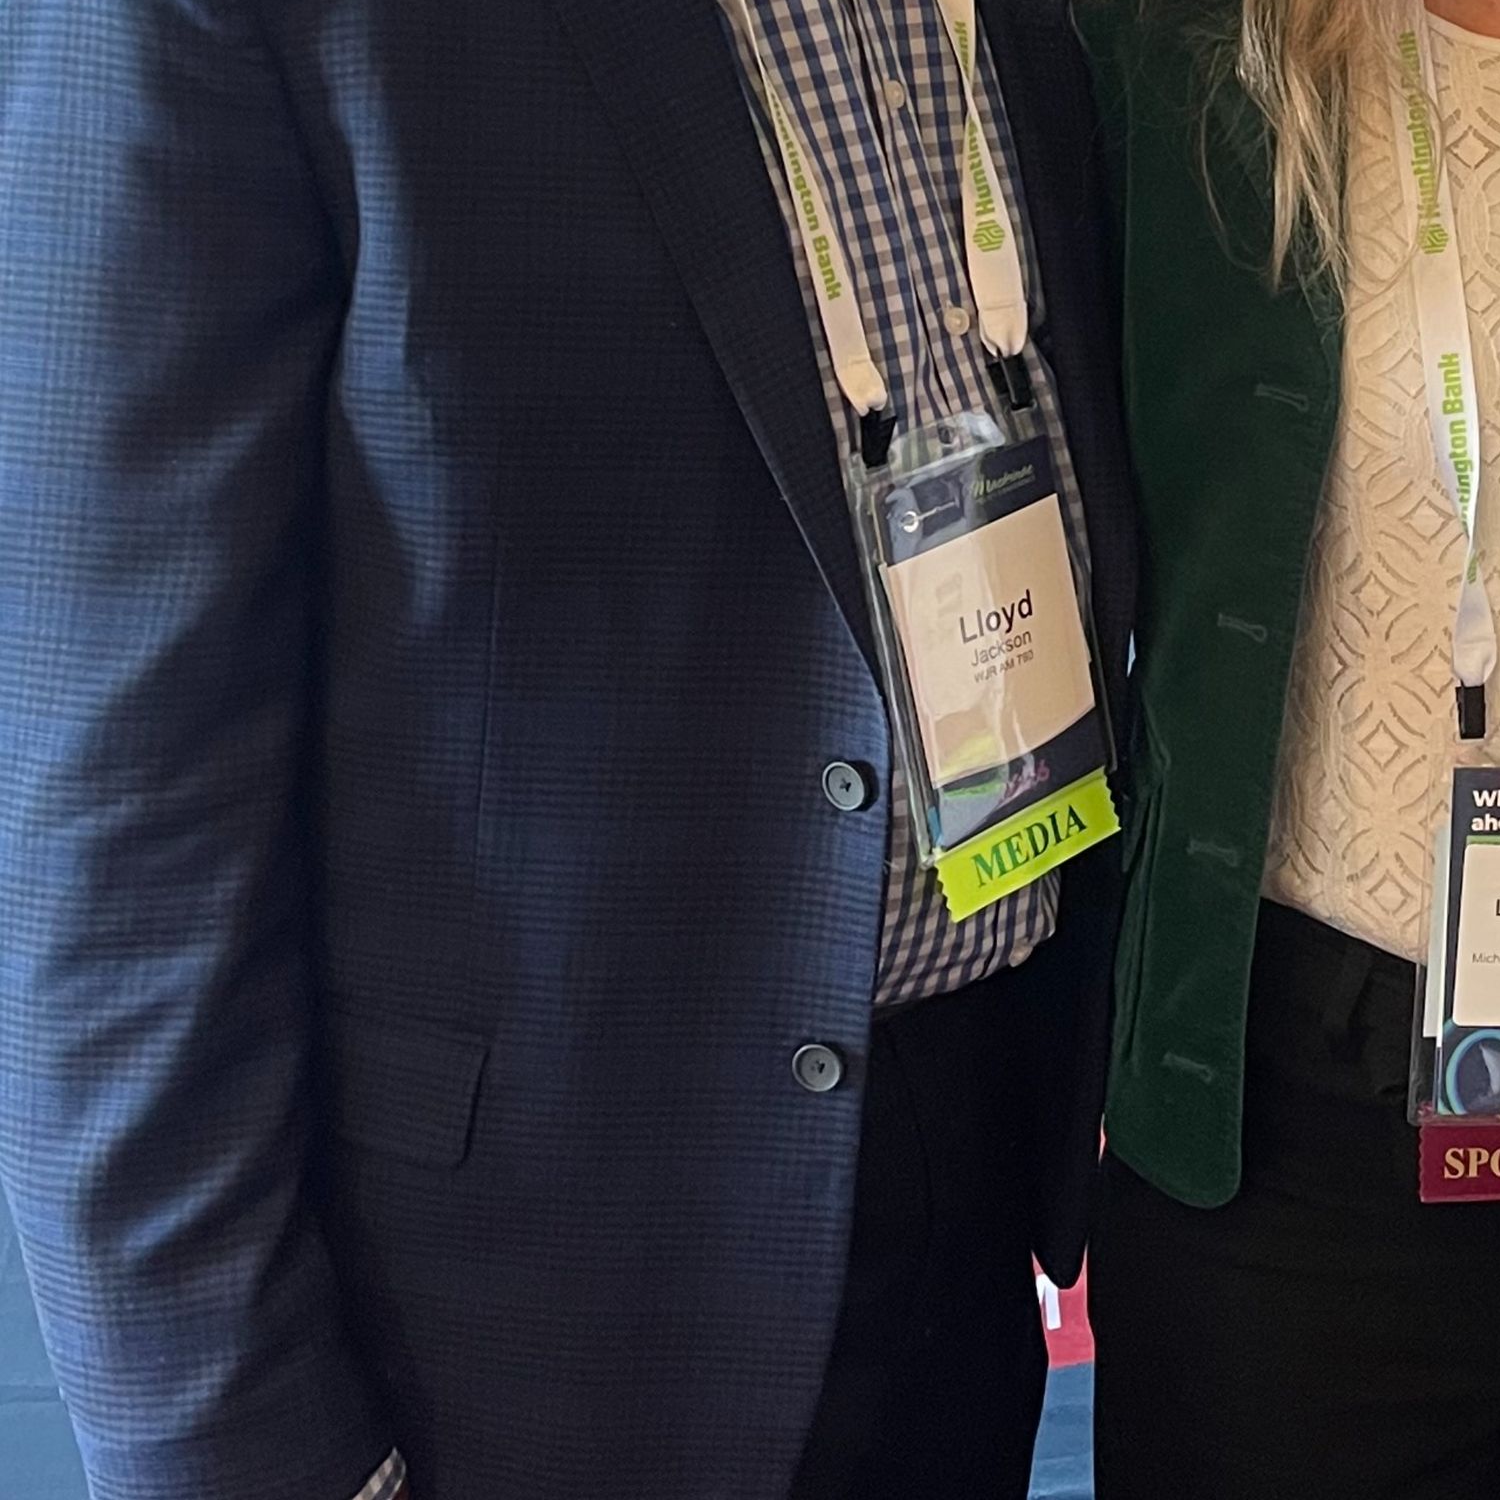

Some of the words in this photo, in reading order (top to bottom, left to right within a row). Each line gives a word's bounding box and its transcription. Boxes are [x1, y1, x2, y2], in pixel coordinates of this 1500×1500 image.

[812, 235, 842, 301] Bank
[1438, 353, 1465, 416] Bank
[959, 587, 1034, 645] Lloyd
[970, 630, 1033, 667] Jackson
[971, 804, 1088, 888] MEDIA
